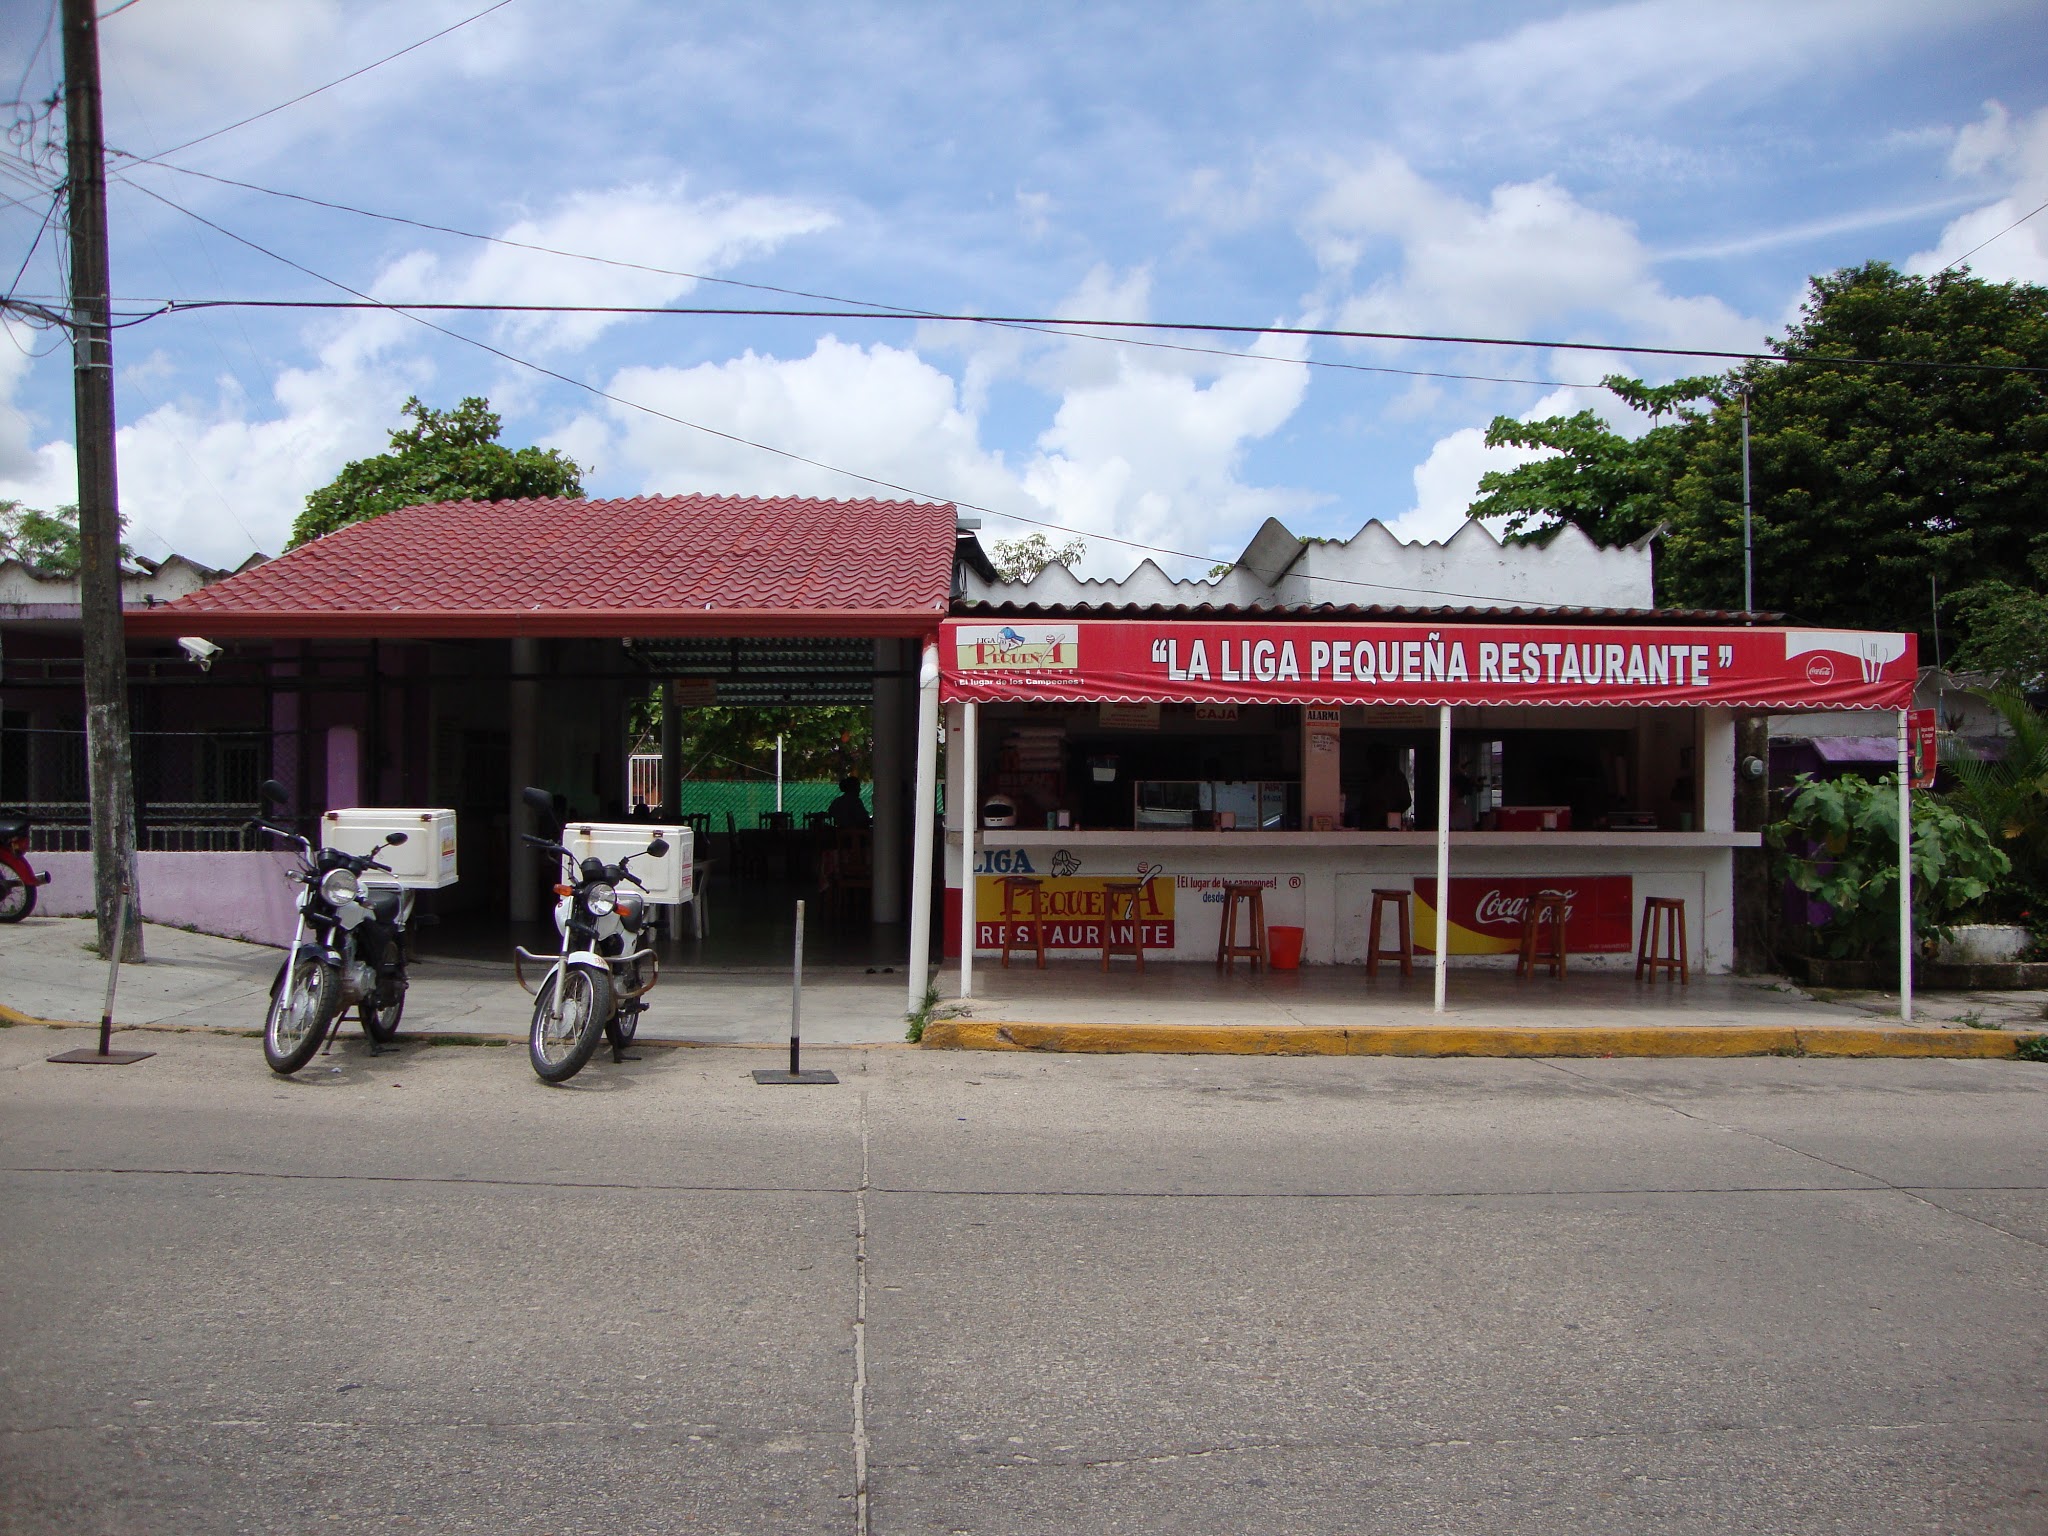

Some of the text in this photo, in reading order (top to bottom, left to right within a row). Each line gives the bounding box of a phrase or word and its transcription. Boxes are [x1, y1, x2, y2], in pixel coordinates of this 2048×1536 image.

[1221, 639, 1300, 682] LIGA
[1311, 632, 1469, 685] PEQUEÑA
[1480, 642, 1710, 686] RESTAURANTE
[1026, 678, 1079, 686] Campeones
[1196, 708, 1237, 720] CAJA
[1307, 710, 1339, 721] ALARMA
[1190, 877, 1211, 892] lugar
[1212, 876, 1221, 888] de
[981, 925, 1168, 944] RESAURNTE
